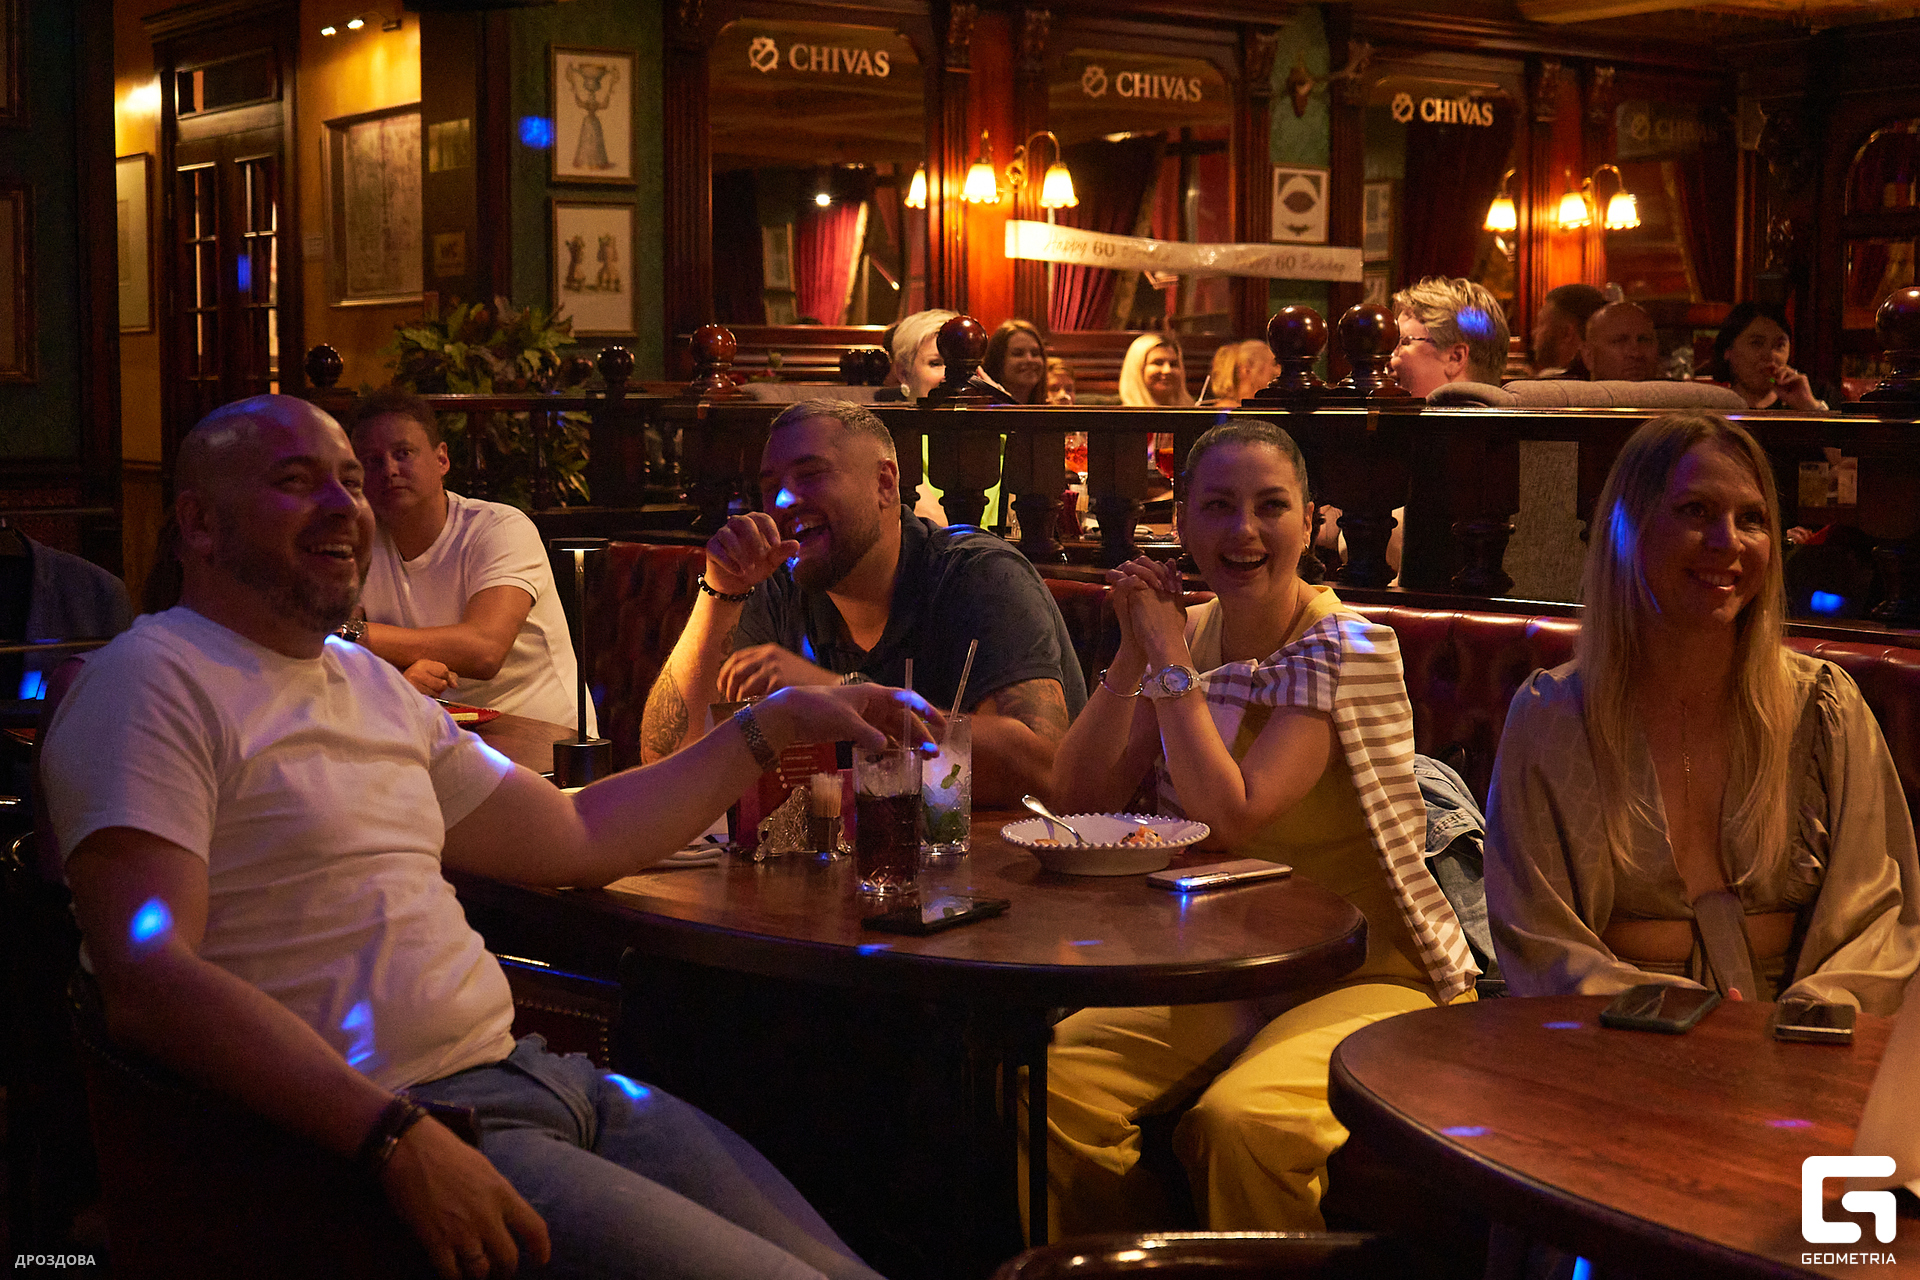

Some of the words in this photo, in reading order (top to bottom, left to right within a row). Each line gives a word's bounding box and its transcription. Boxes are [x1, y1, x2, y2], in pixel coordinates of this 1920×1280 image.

[789, 43, 890, 77] CHIVAS
[1116, 71, 1202, 102] CHIVAS
[1421, 97, 1493, 127] CHIVAS
[1093, 241, 1115, 258] 60
